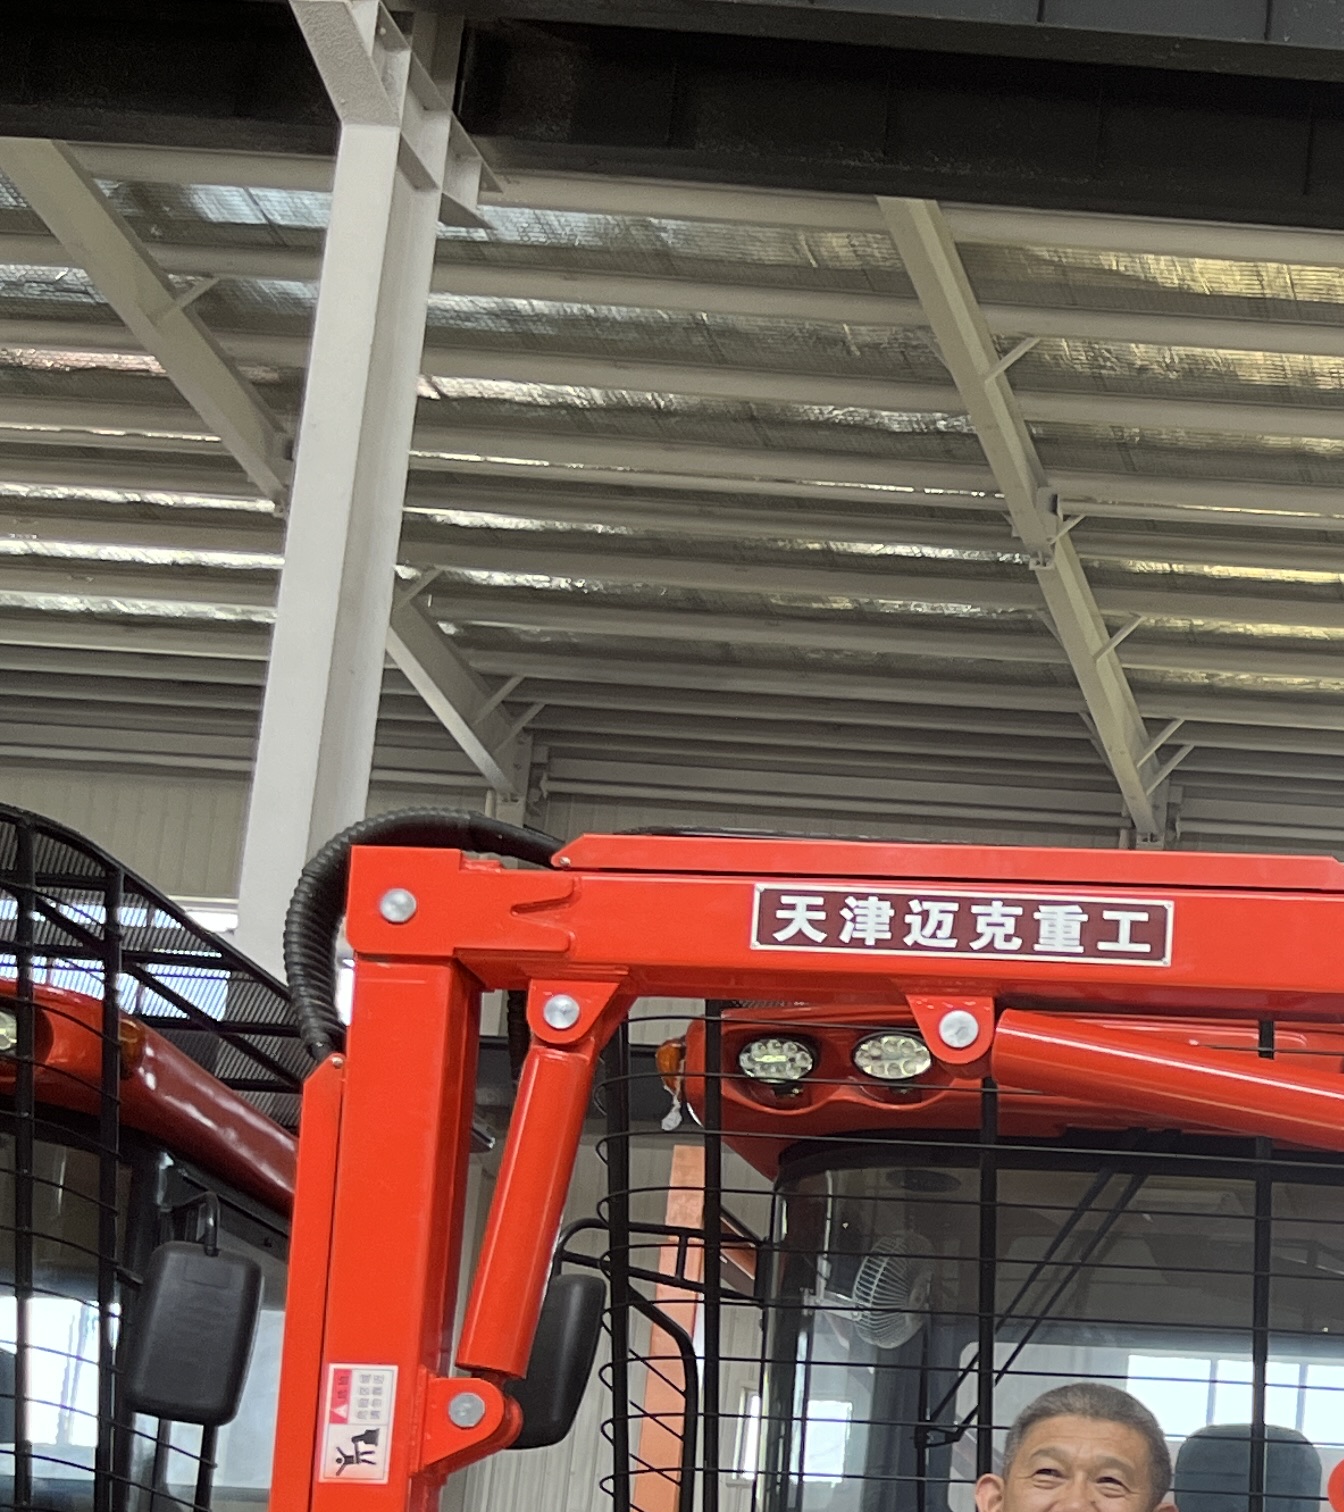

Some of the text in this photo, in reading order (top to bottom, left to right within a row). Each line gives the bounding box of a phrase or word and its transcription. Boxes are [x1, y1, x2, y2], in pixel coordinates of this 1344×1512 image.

[772, 895, 1151, 954] 天津迈克重工
